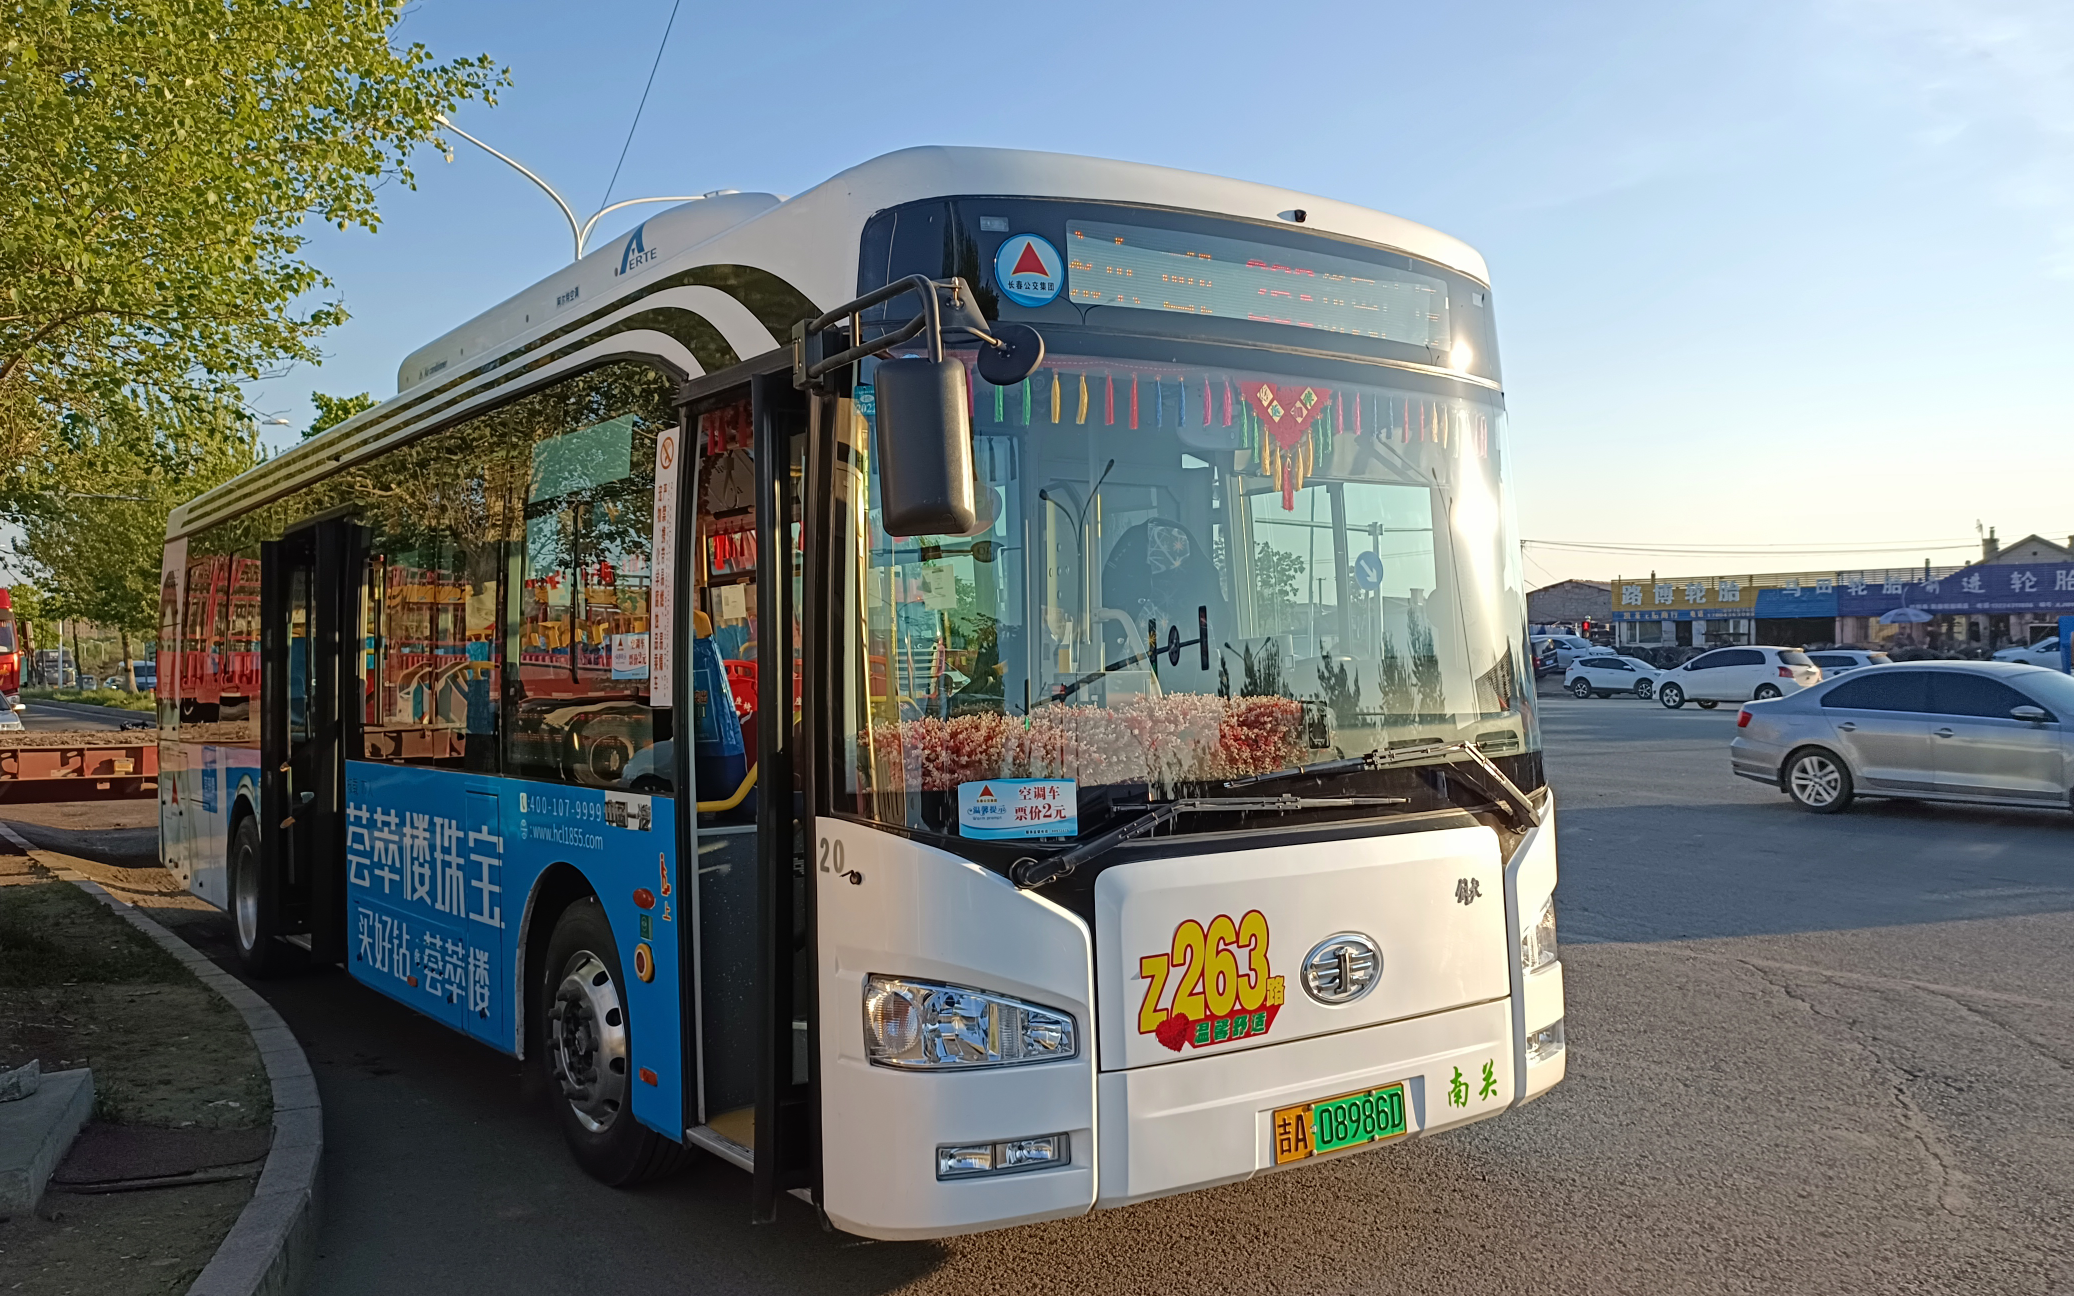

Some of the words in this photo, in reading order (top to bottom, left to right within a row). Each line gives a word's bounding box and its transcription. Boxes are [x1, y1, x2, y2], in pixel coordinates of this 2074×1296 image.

[1008, 280, 1055, 292] 长春公交集团
[1621, 580, 1741, 606] 路博轮胎
[1019, 786, 1060, 800] 空调车
[967, 805, 1007, 816] 温馨提示
[1014, 803, 1067, 821] 票价2元
[346, 802, 505, 929] 荟萃楼珠宝
[820, 837, 845, 873] 20
[1193, 1011, 1267, 1046] 温馨舒适
[1447, 1059, 1498, 1109] 南关
